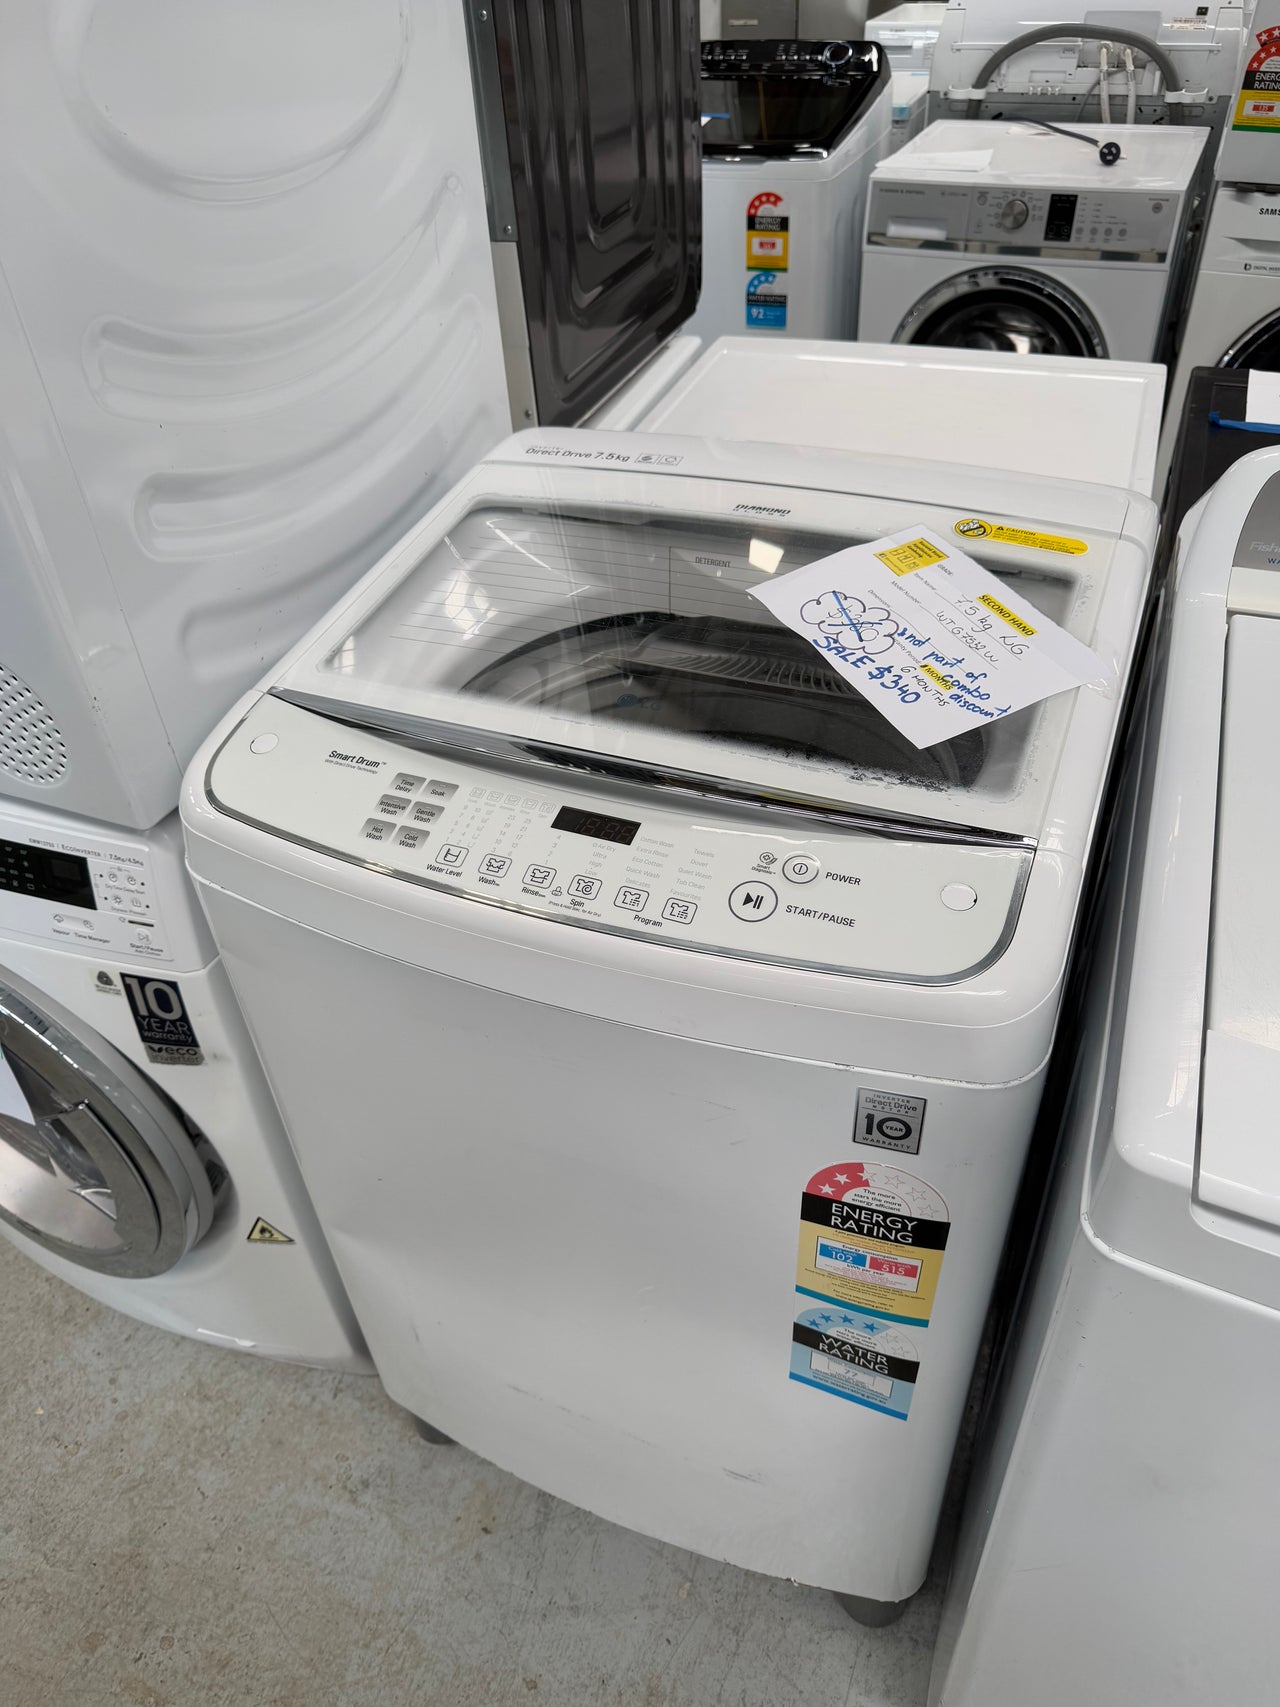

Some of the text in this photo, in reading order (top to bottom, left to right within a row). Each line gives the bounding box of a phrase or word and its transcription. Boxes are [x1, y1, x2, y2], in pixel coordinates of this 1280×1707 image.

[526, 448, 560, 456] Direct
[562, 450, 592, 459] Drive
[735, 504, 791, 515] DIAMOND
[1006, 528, 1036, 536] CAUTION
[695, 556, 731, 568] DETERGENT
[979, 594, 1034, 637] SECOND HAND
[999, 636, 1030, 655] LG
[812, 636, 876, 668] SALE
[868, 665, 922, 704] $340
[922, 651, 966, 668] part
[965, 672, 988, 684] of
[900, 666, 950, 707] 6 MONTHS
[940, 674, 991, 701] combo
[949, 693, 1012, 719] discount
[328, 750, 356, 763] Smart
[395, 785, 412, 793] Delay
[430, 789, 446, 797] Soak
[380, 800, 406, 811] Intensive
[380, 808, 398, 816] Wash
[414, 815, 431, 824] Wash
[416, 808, 436, 818] Gentle
[366, 832, 382, 840] Wash
[404, 834, 418, 842] Cold
[398, 840, 416, 848] Wash
[593, 851, 607, 860] Ultra
[426, 864, 463, 878] Water Level
[626, 866, 661, 880] Quick Wash
[678, 866, 713, 880] Quiet Wash
[478, 876, 496, 886] Wash
[826, 871, 861, 886] POWER
[522, 887, 540, 897] Rinse
[570, 898, 585, 908] Spin
[634, 914, 663, 928] Program
[786, 904, 856, 928] START/PAUSE
[124, 976, 182, 1020] 10
[137, 1016, 190, 1034] YEAR
[143, 1030, 192, 1044] warranty
[165, 1046, 198, 1056] eco
[864, 1096, 918, 1112] Direct Drive
[874, 1094, 910, 1104] INVERTER
[872, 1105, 910, 1114] MOTOR
[864, 1112, 912, 1140] 10
[885, 1125, 904, 1133] YEAR
[862, 1136, 911, 1150] WARRANTY
[852, 1198, 900, 1212] energy efficient
[884, 1200, 902, 1208] more
[832, 1203, 918, 1232] ENERGY
[831, 1216, 914, 1244] RATING
[842, 1244, 862, 1253] Energy
[831, 1251, 854, 1264] 102
[881, 1264, 906, 1276] 515
[821, 1334, 888, 1366] WATER
[820, 1342, 889, 1374] RATING
